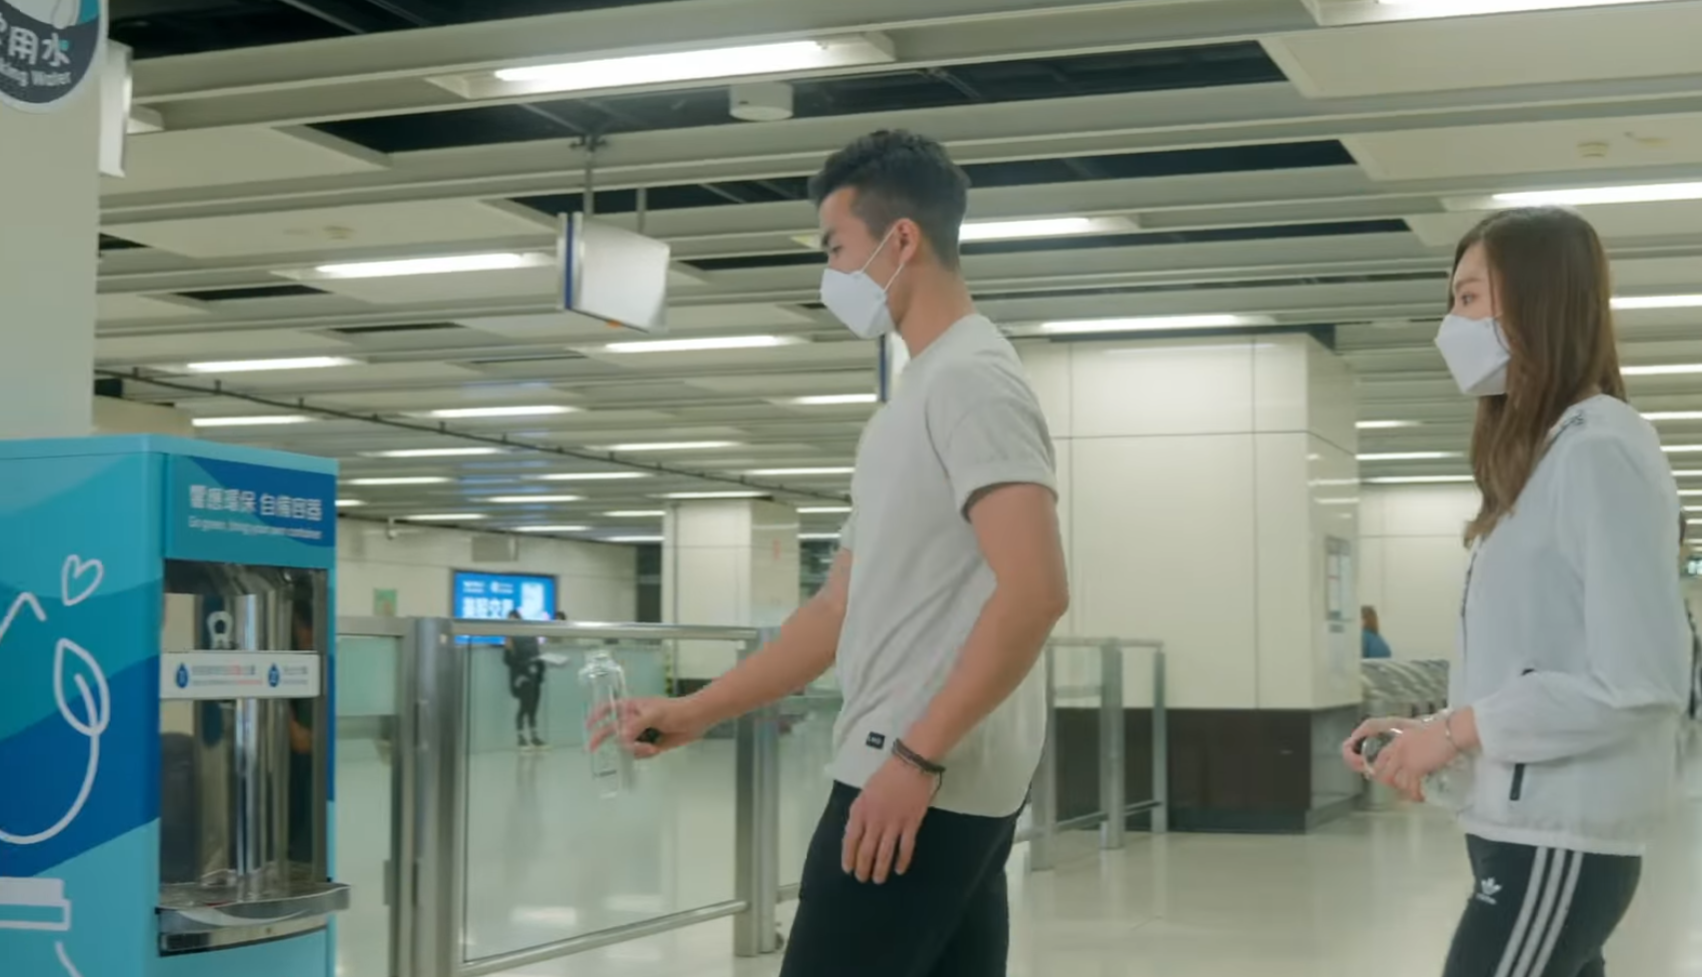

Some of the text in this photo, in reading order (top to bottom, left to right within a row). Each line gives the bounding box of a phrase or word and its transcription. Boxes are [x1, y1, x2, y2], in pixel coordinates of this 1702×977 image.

[31, 70, 71, 86] Water
[260, 493, 322, 521] 自備容器
